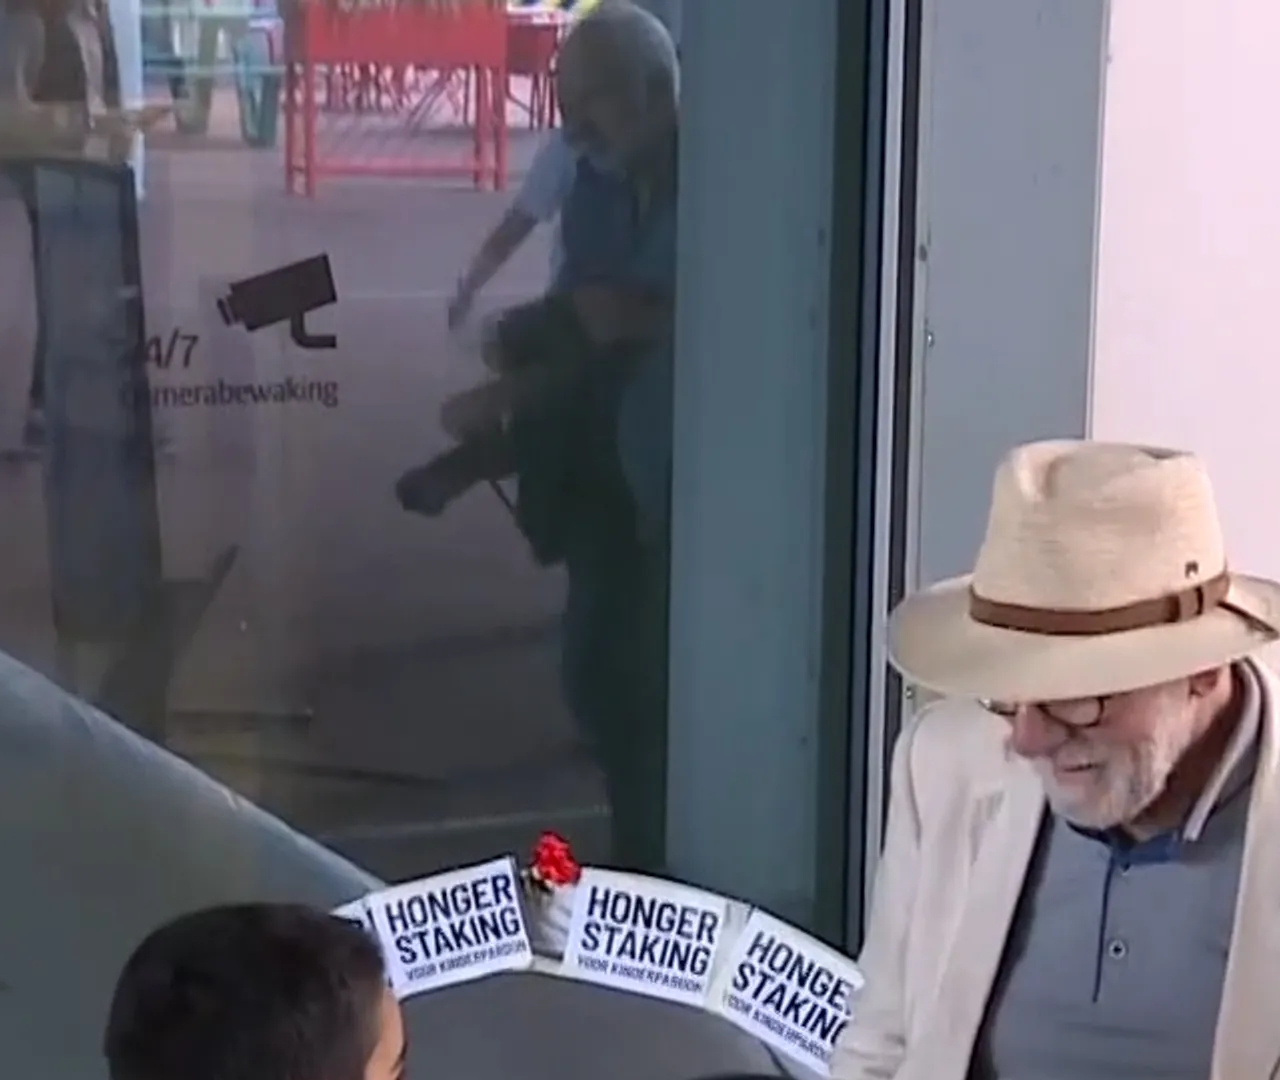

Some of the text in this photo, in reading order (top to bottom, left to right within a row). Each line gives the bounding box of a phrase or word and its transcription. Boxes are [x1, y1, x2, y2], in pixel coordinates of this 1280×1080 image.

[144, 328, 199, 369] 4/7
[385, 873, 513, 936] HONGER
[587, 886, 718, 945] HONGER
[395, 906, 520, 964] STAKING
[581, 920, 711, 976] STAKING
[746, 930, 854, 1016] HONGE
